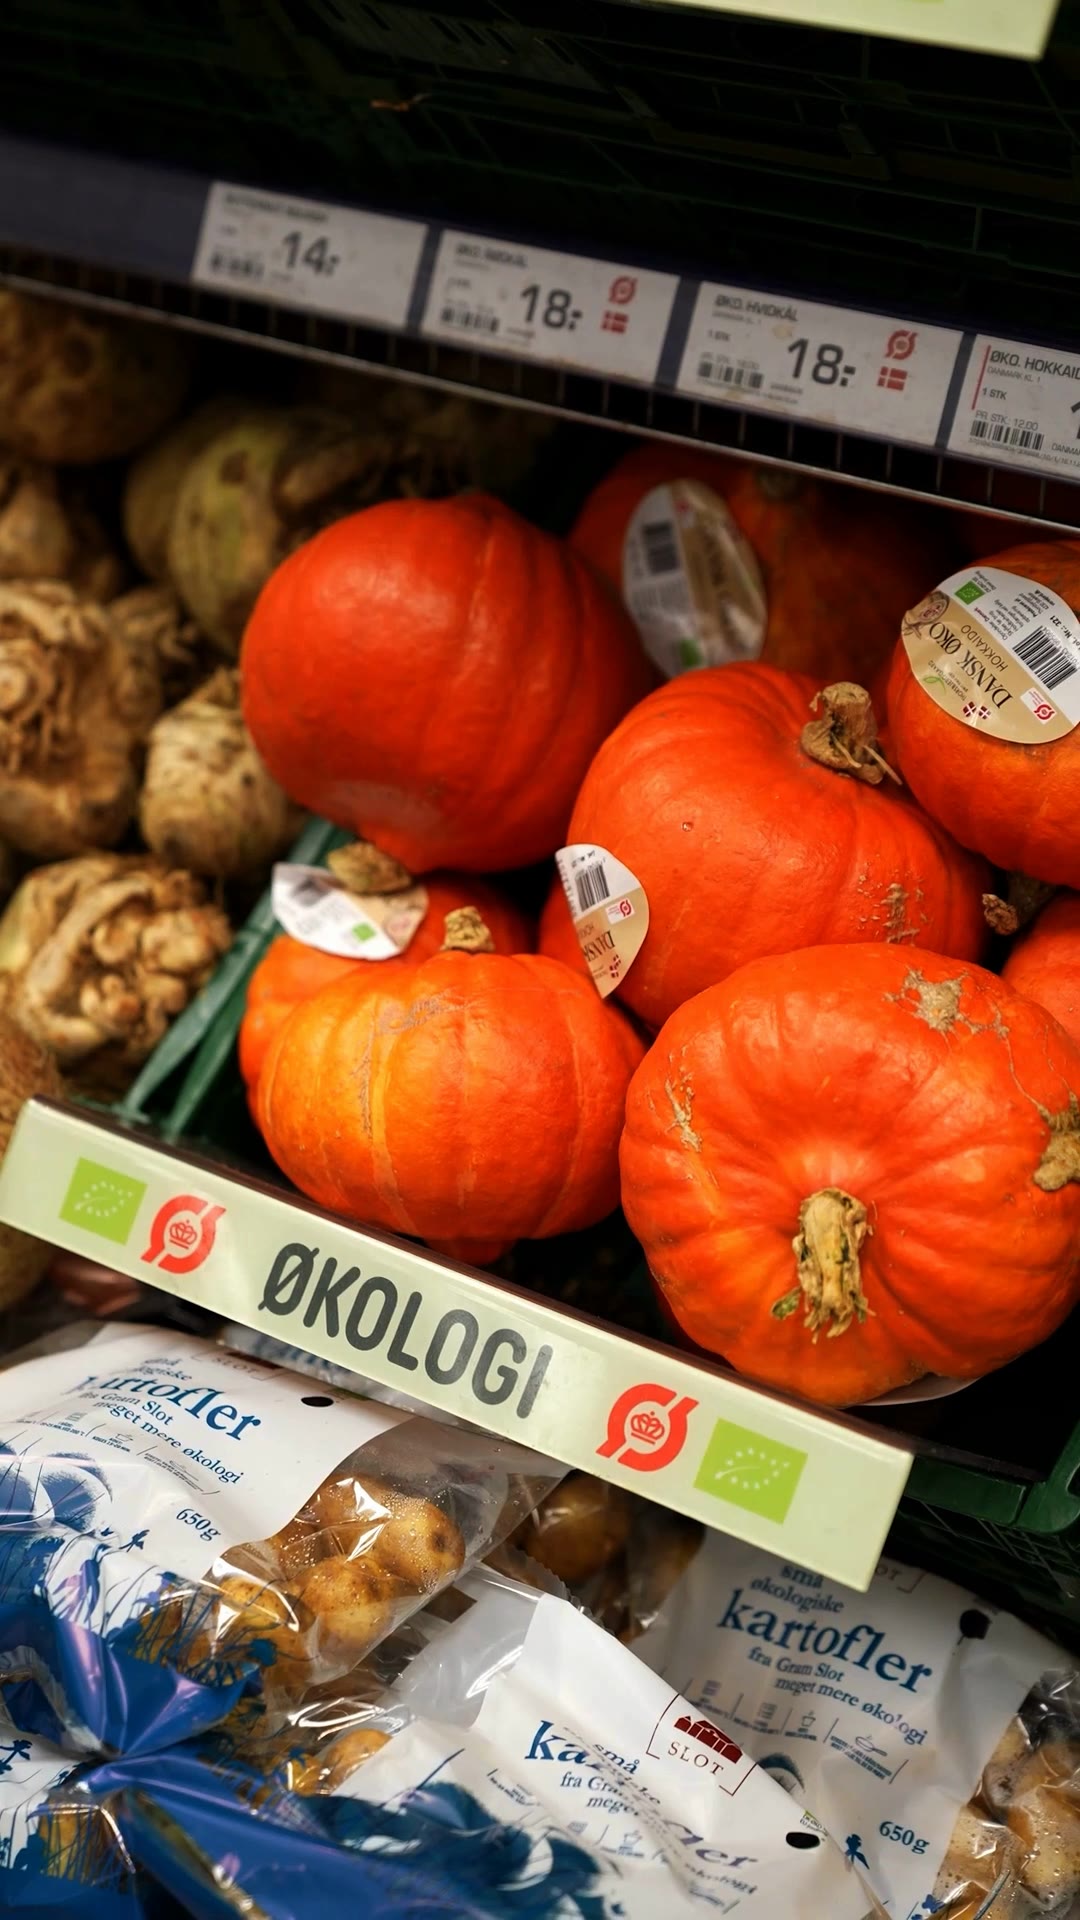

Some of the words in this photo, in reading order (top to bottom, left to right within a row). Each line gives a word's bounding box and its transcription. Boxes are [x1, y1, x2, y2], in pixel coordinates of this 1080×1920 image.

[748, 301, 798, 322] HVIDKÅL
[987, 366, 1023, 380] DANMARK
[990, 350, 1021, 367] ØKO.
[989, 389, 1007, 400] STK
[1013, 418, 1039, 431] 12.00
[1049, 614, 1062, 627] 321
[928, 622, 963, 656] ØKO
[959, 622, 1008, 672] HOKKAIDO
[957, 650, 1013, 709] DANSK
[259, 1242, 554, 1418] ØKOLOGI
[143, 1401, 174, 1426] Slot
[141, 1422, 182, 1448] mere
[182, 1448, 244, 1484] økologi
[176, 1508, 222, 1542] 650g
[751, 1576, 845, 1614] økologiske
[717, 1588, 932, 1693] kartofler
[748, 1647, 771, 1668] fra
[776, 1657, 812, 1677] Gram
[814, 1662, 845, 1683] Slot
[774, 1676, 815, 1696] meget
[817, 1682, 859, 1708] mere
[592, 1743, 640, 1775] små
[667, 1741, 725, 1776] SLOT
[560, 1771, 582, 1788] fra
[879, 1820, 930, 1855] 650g
